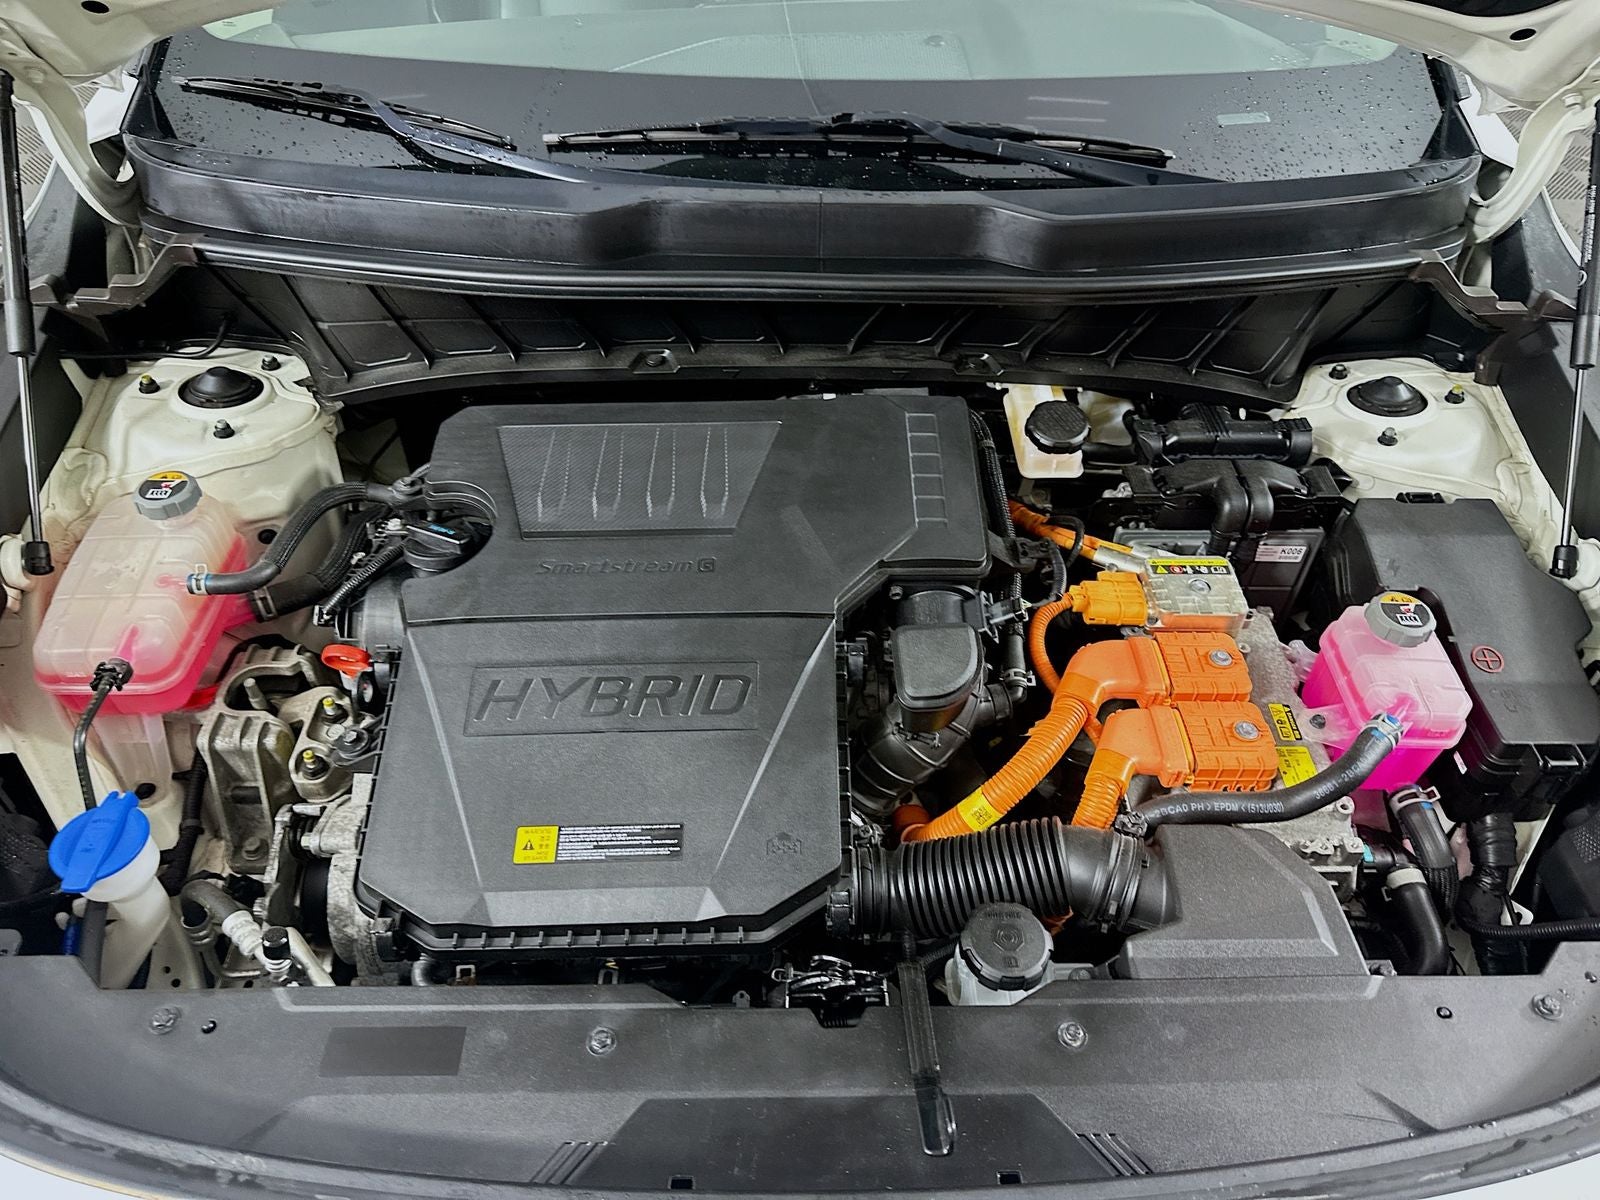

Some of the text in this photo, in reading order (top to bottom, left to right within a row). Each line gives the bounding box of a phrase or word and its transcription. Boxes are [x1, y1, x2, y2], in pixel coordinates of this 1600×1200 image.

[535, 557, 694, 575] Smartstream
[473, 673, 752, 722] HYBRID
[1190, 802, 1205, 811] PH
